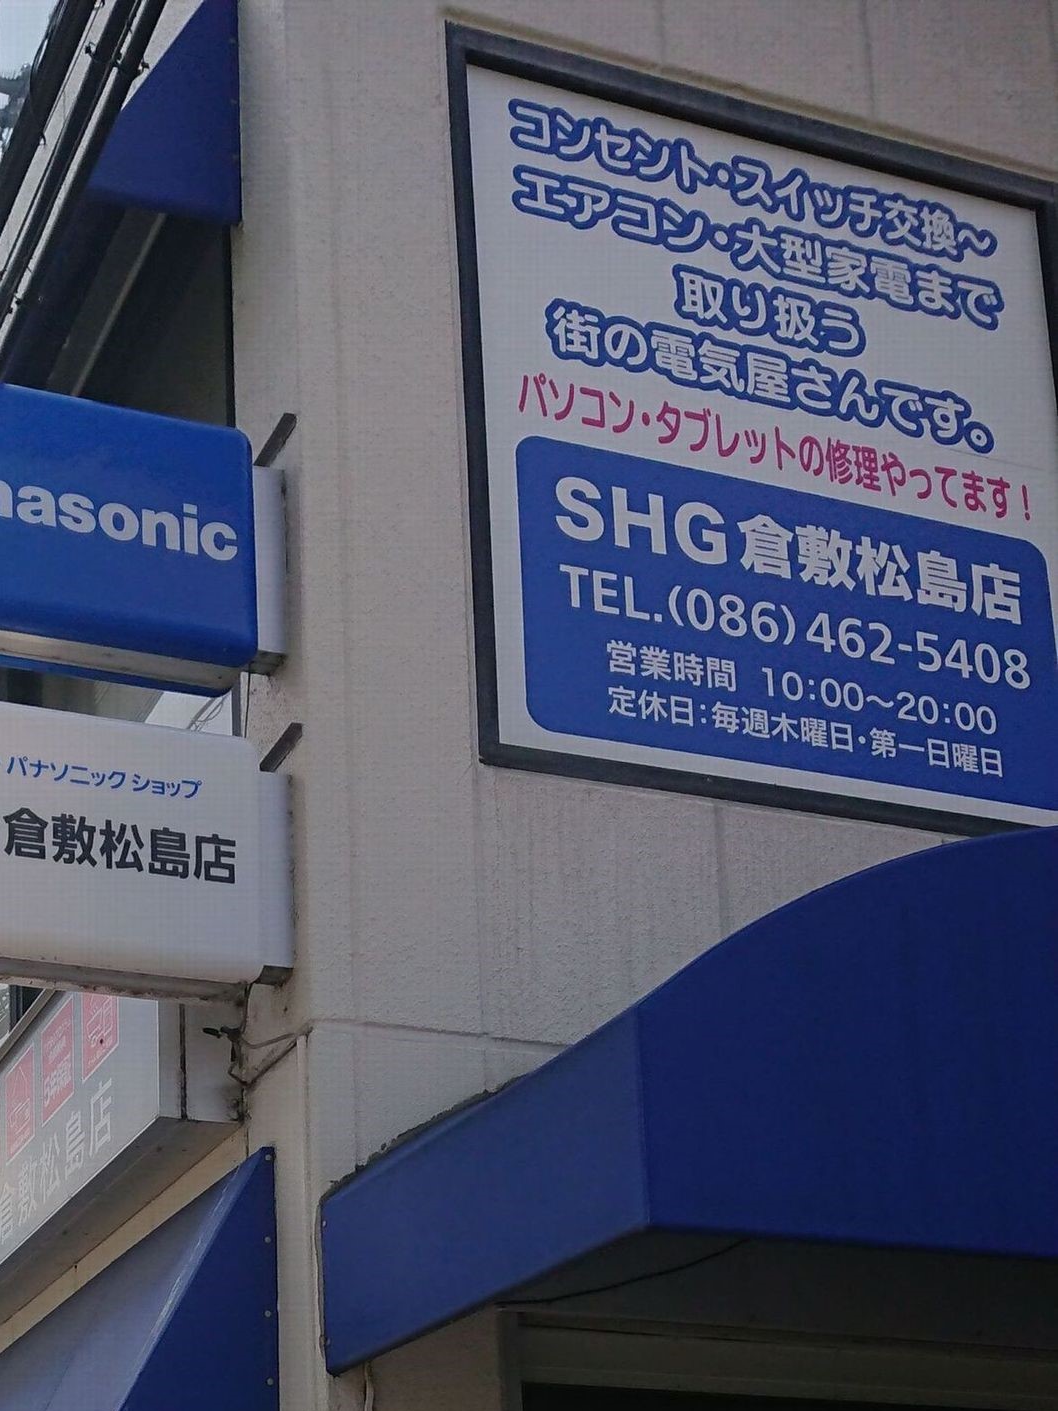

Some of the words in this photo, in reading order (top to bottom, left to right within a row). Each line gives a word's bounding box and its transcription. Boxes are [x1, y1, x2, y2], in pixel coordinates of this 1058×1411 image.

[512, 164, 1004, 331] エアコン・大型家電まで
[673, 264, 866, 358] 取り扱う
[545, 297, 994, 454] 街の電気屋さんです。
[606, 640, 736, 692] 営業時間
[7, 755, 126, 791] パナソニック
[132, 773, 202, 799] ショップ
